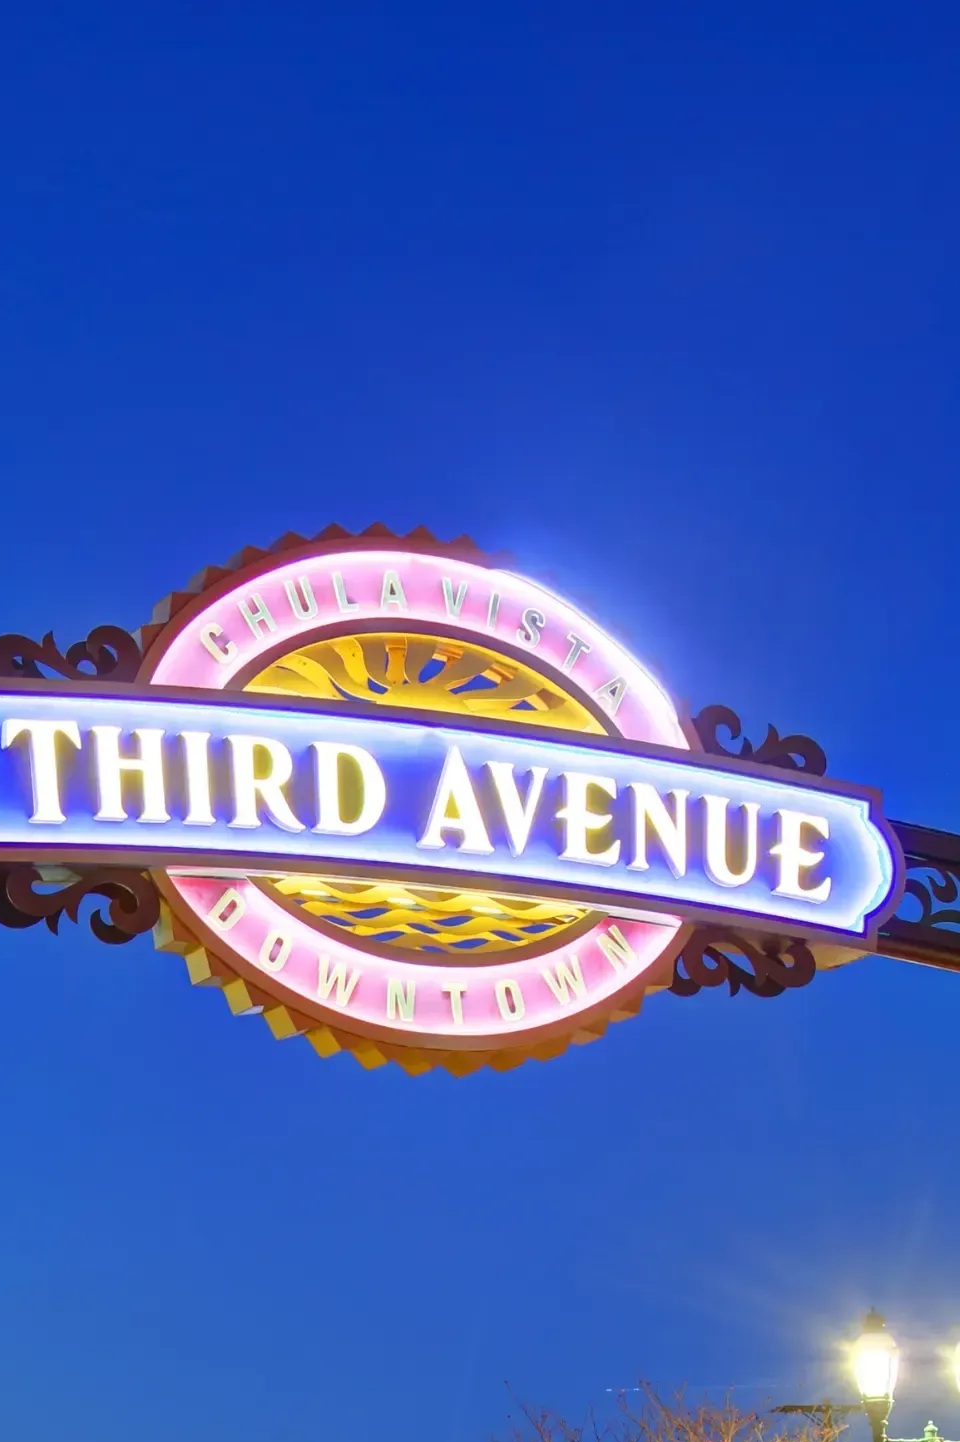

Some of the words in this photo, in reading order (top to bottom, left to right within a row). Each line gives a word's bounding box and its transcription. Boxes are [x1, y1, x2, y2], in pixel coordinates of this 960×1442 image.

[199, 569, 409, 666] CHULA
[440, 575, 630, 718] VISTA
[0, 718, 389, 838] THIRD
[416, 744, 834, 906] AVENUE
[207, 886, 639, 1026] DOWNTOWN
